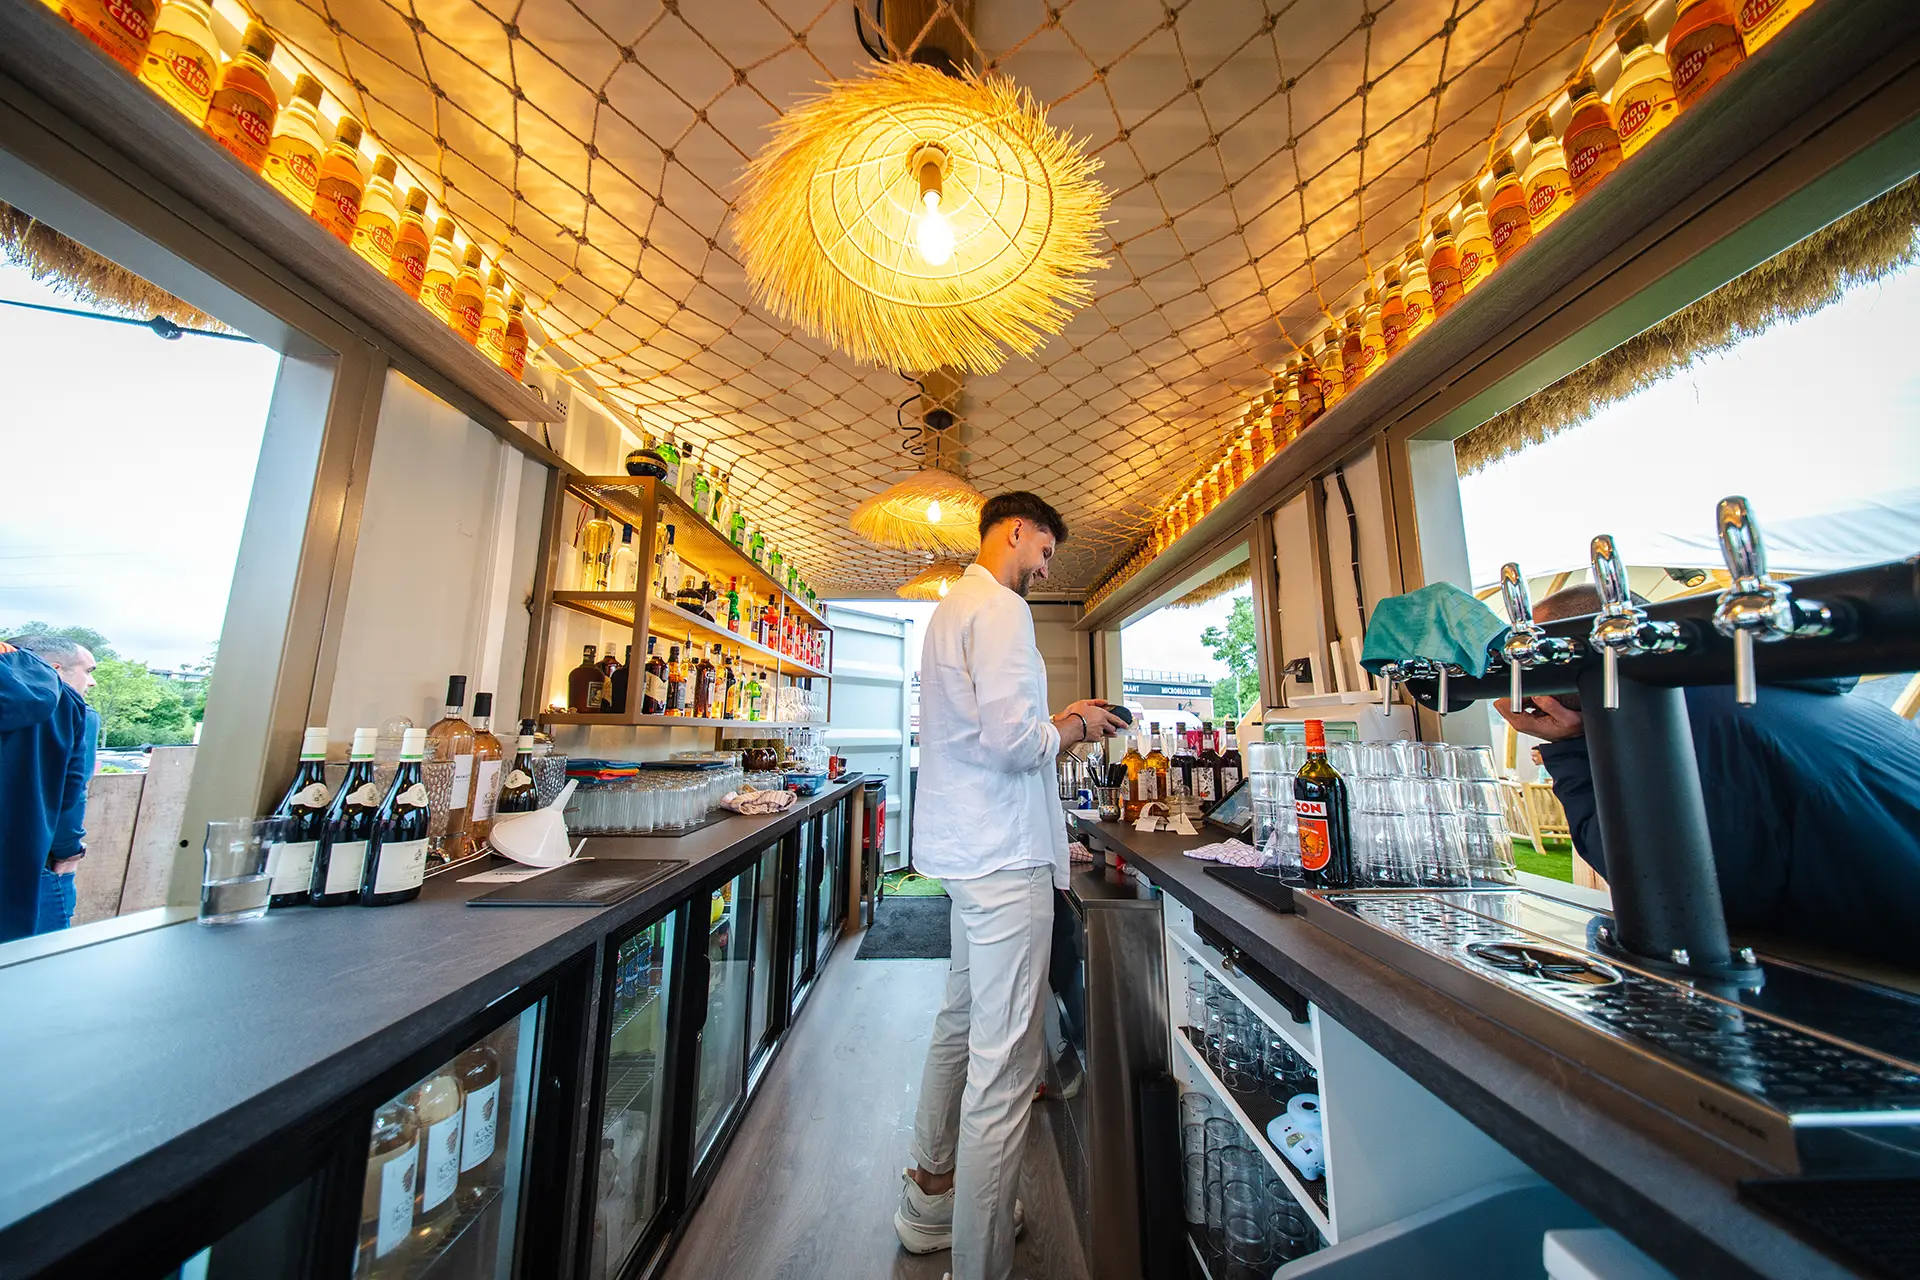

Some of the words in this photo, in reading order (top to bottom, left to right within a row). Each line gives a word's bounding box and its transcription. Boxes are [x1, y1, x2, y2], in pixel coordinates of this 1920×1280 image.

[108, 4, 145, 39] Club
[1675, 41, 1714, 81] avana
[176, 65, 207, 95] Club
[1675, 61, 1703, 89] Club
[1619, 94, 1659, 128] avana
[1621, 111, 1646, 137] Club
[241, 119, 268, 146] Club
[1570, 141, 1604, 173] avana
[1572, 156, 1595, 179] Club
[292, 163, 316, 187] Club
[1530, 195, 1552, 215] Club
[1123, 684, 1140, 693] RANT
[1295, 801, 1322, 814] CON
